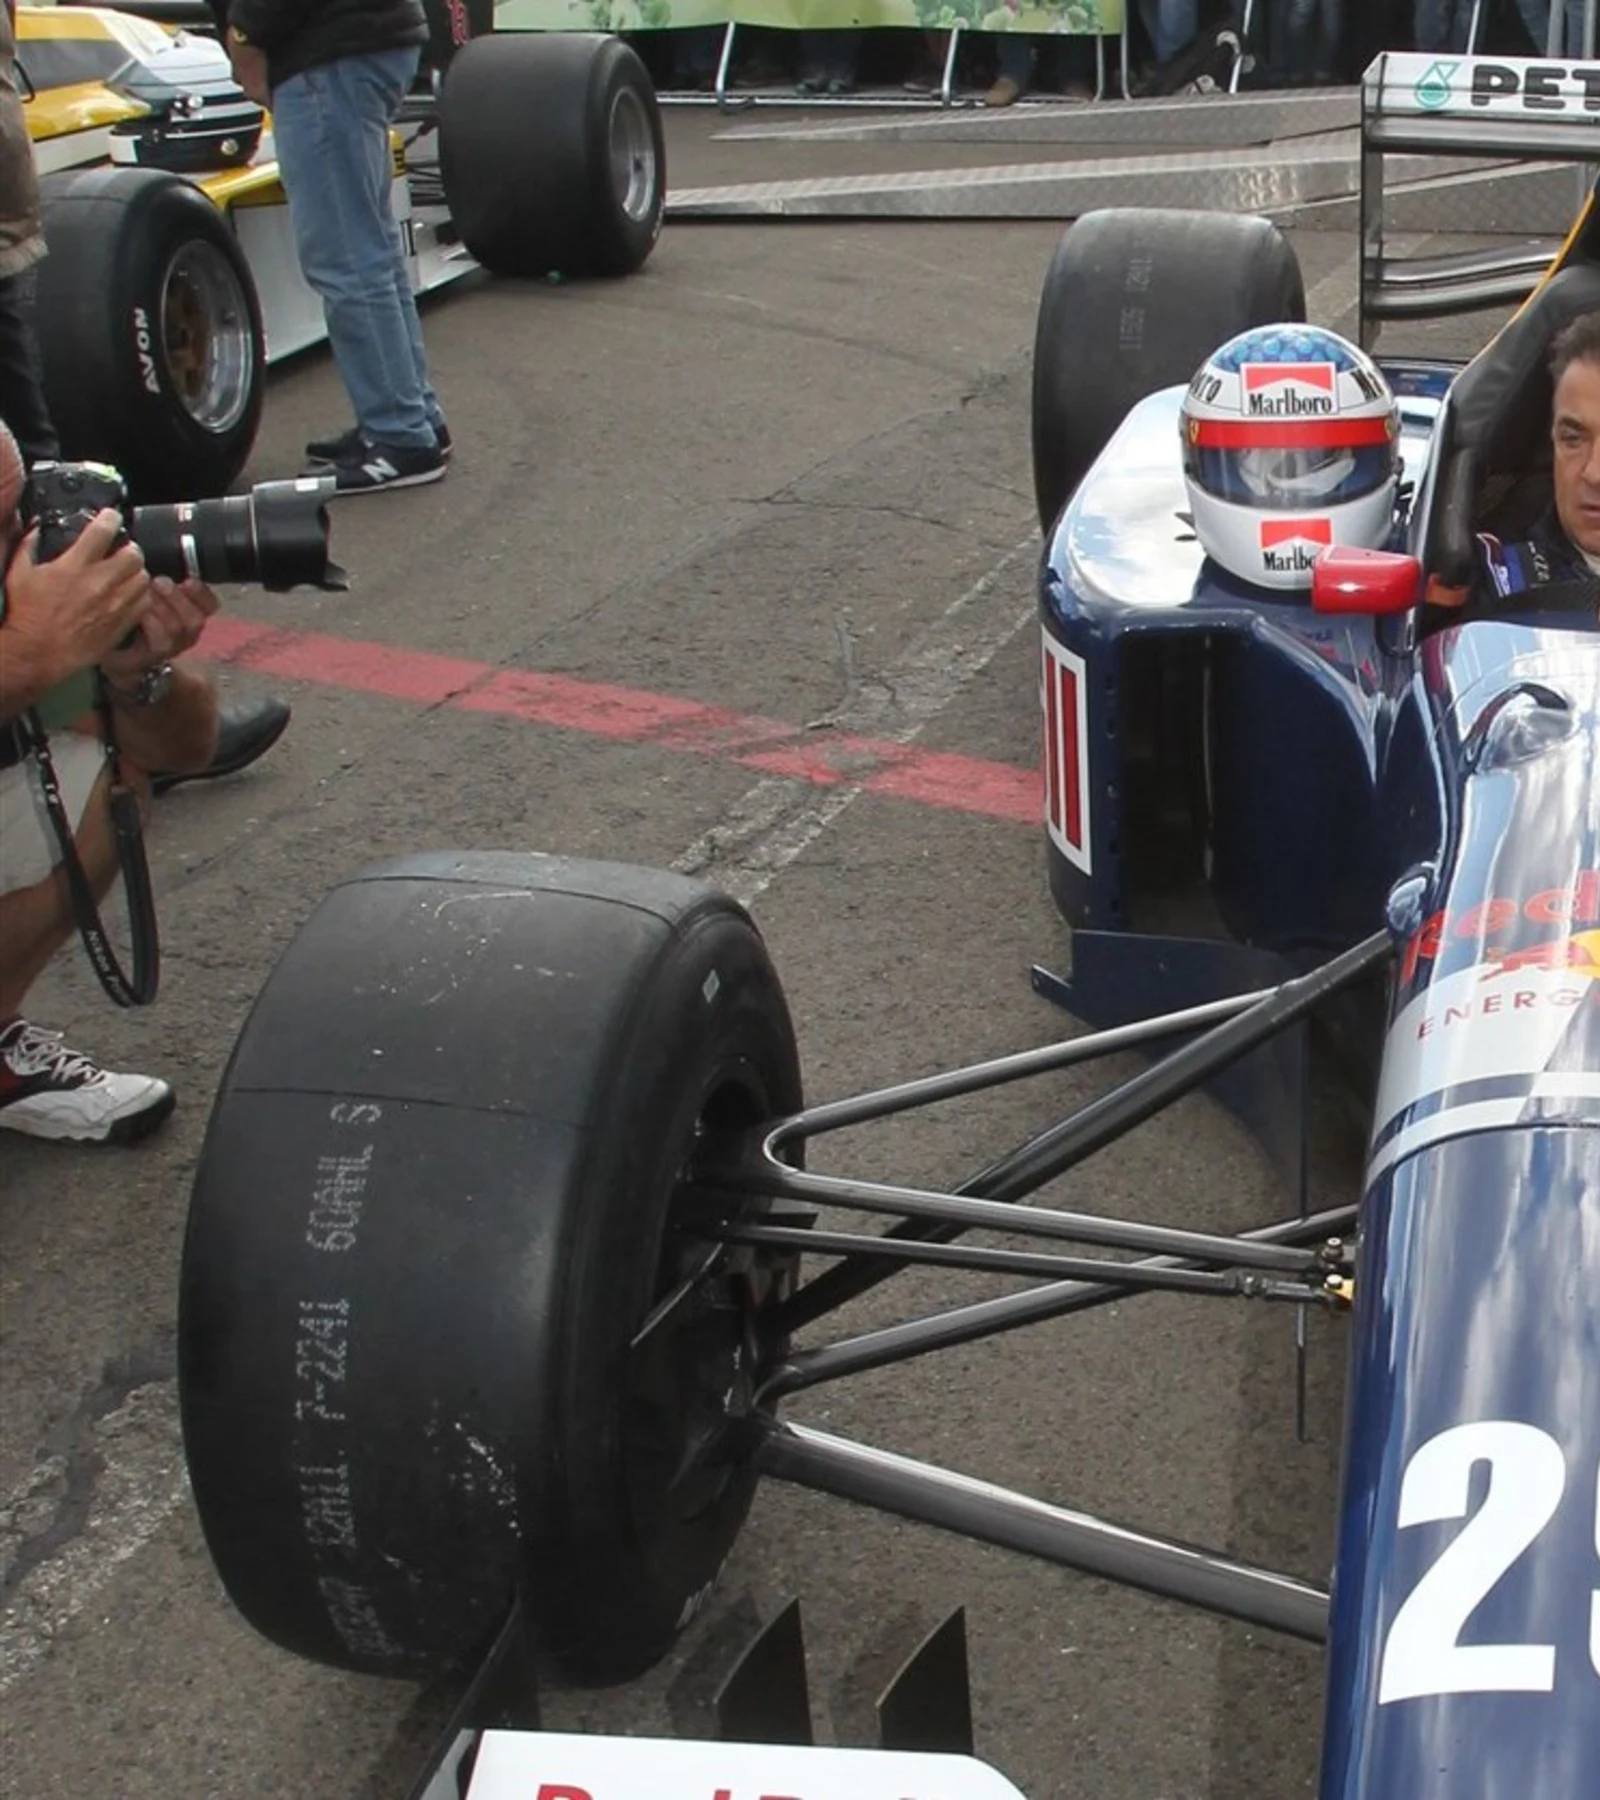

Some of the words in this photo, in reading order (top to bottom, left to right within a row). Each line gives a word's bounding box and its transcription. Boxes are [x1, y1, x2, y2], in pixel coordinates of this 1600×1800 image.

[133, 306, 161, 394] AVON
[1249, 387, 1332, 416] Marlboro
[1263, 546, 1316, 571] Marlbo
